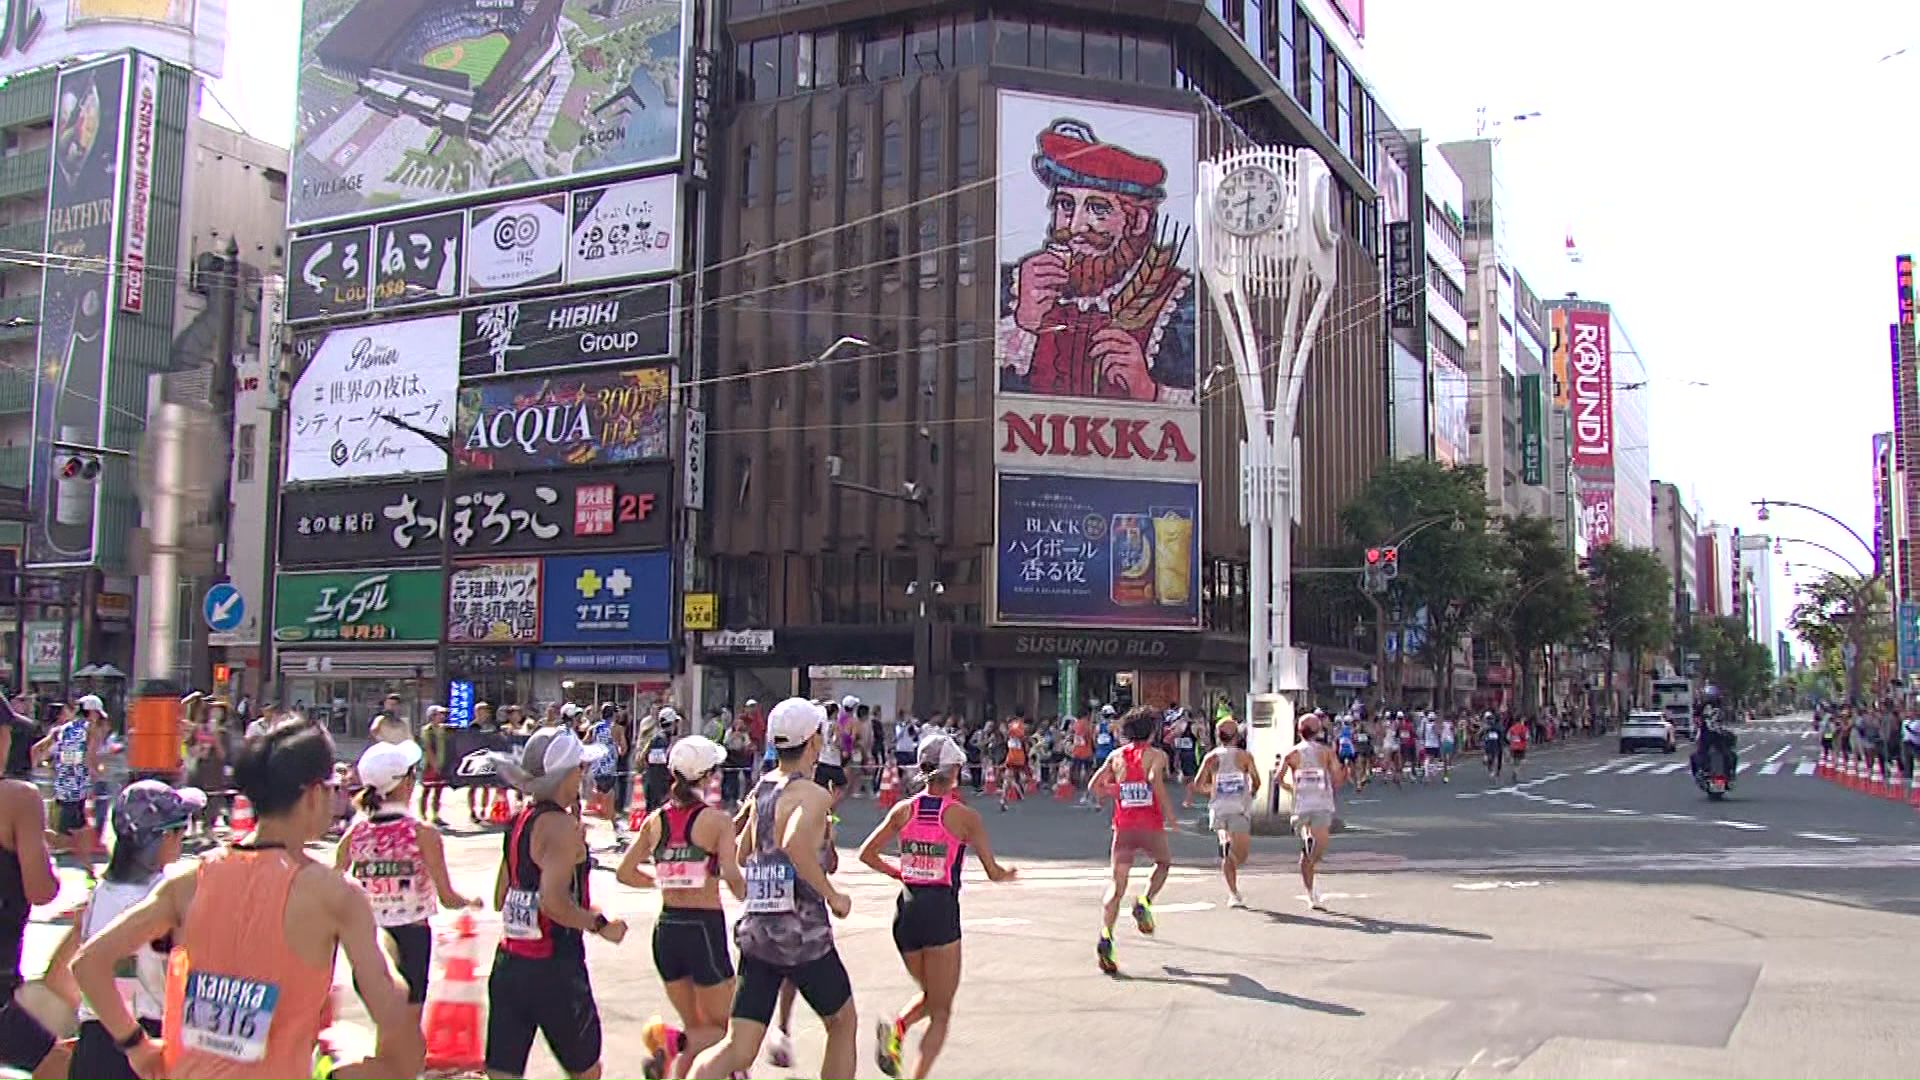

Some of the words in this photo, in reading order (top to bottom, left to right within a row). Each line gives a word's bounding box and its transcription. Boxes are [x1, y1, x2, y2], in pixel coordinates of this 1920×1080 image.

[312, 173, 364, 198] VILLAGE
[303, 229, 433, 294] くろねこ
[547, 300, 620, 330] HIBIKI
[579, 330, 639, 354] Group
[1574, 323, 1609, 455] ROUND1
[465, 402, 592, 454] ACQUA
[999, 411, 1197, 462] NIKKA
[383, 486, 561, 549] さっぽろっこ
[618, 494, 656, 522] 2F
[1025, 517, 1081, 535] BLACK
[1007, 538, 1099, 559] ハイボール
[1019, 557, 1087, 583] 香る夜
[307, 576, 391, 623] エイブル
[1015, 634, 1119, 656] SUSUKINO
[756, 881, 785, 900] 315
[206, 1003, 257, 1039] 316
